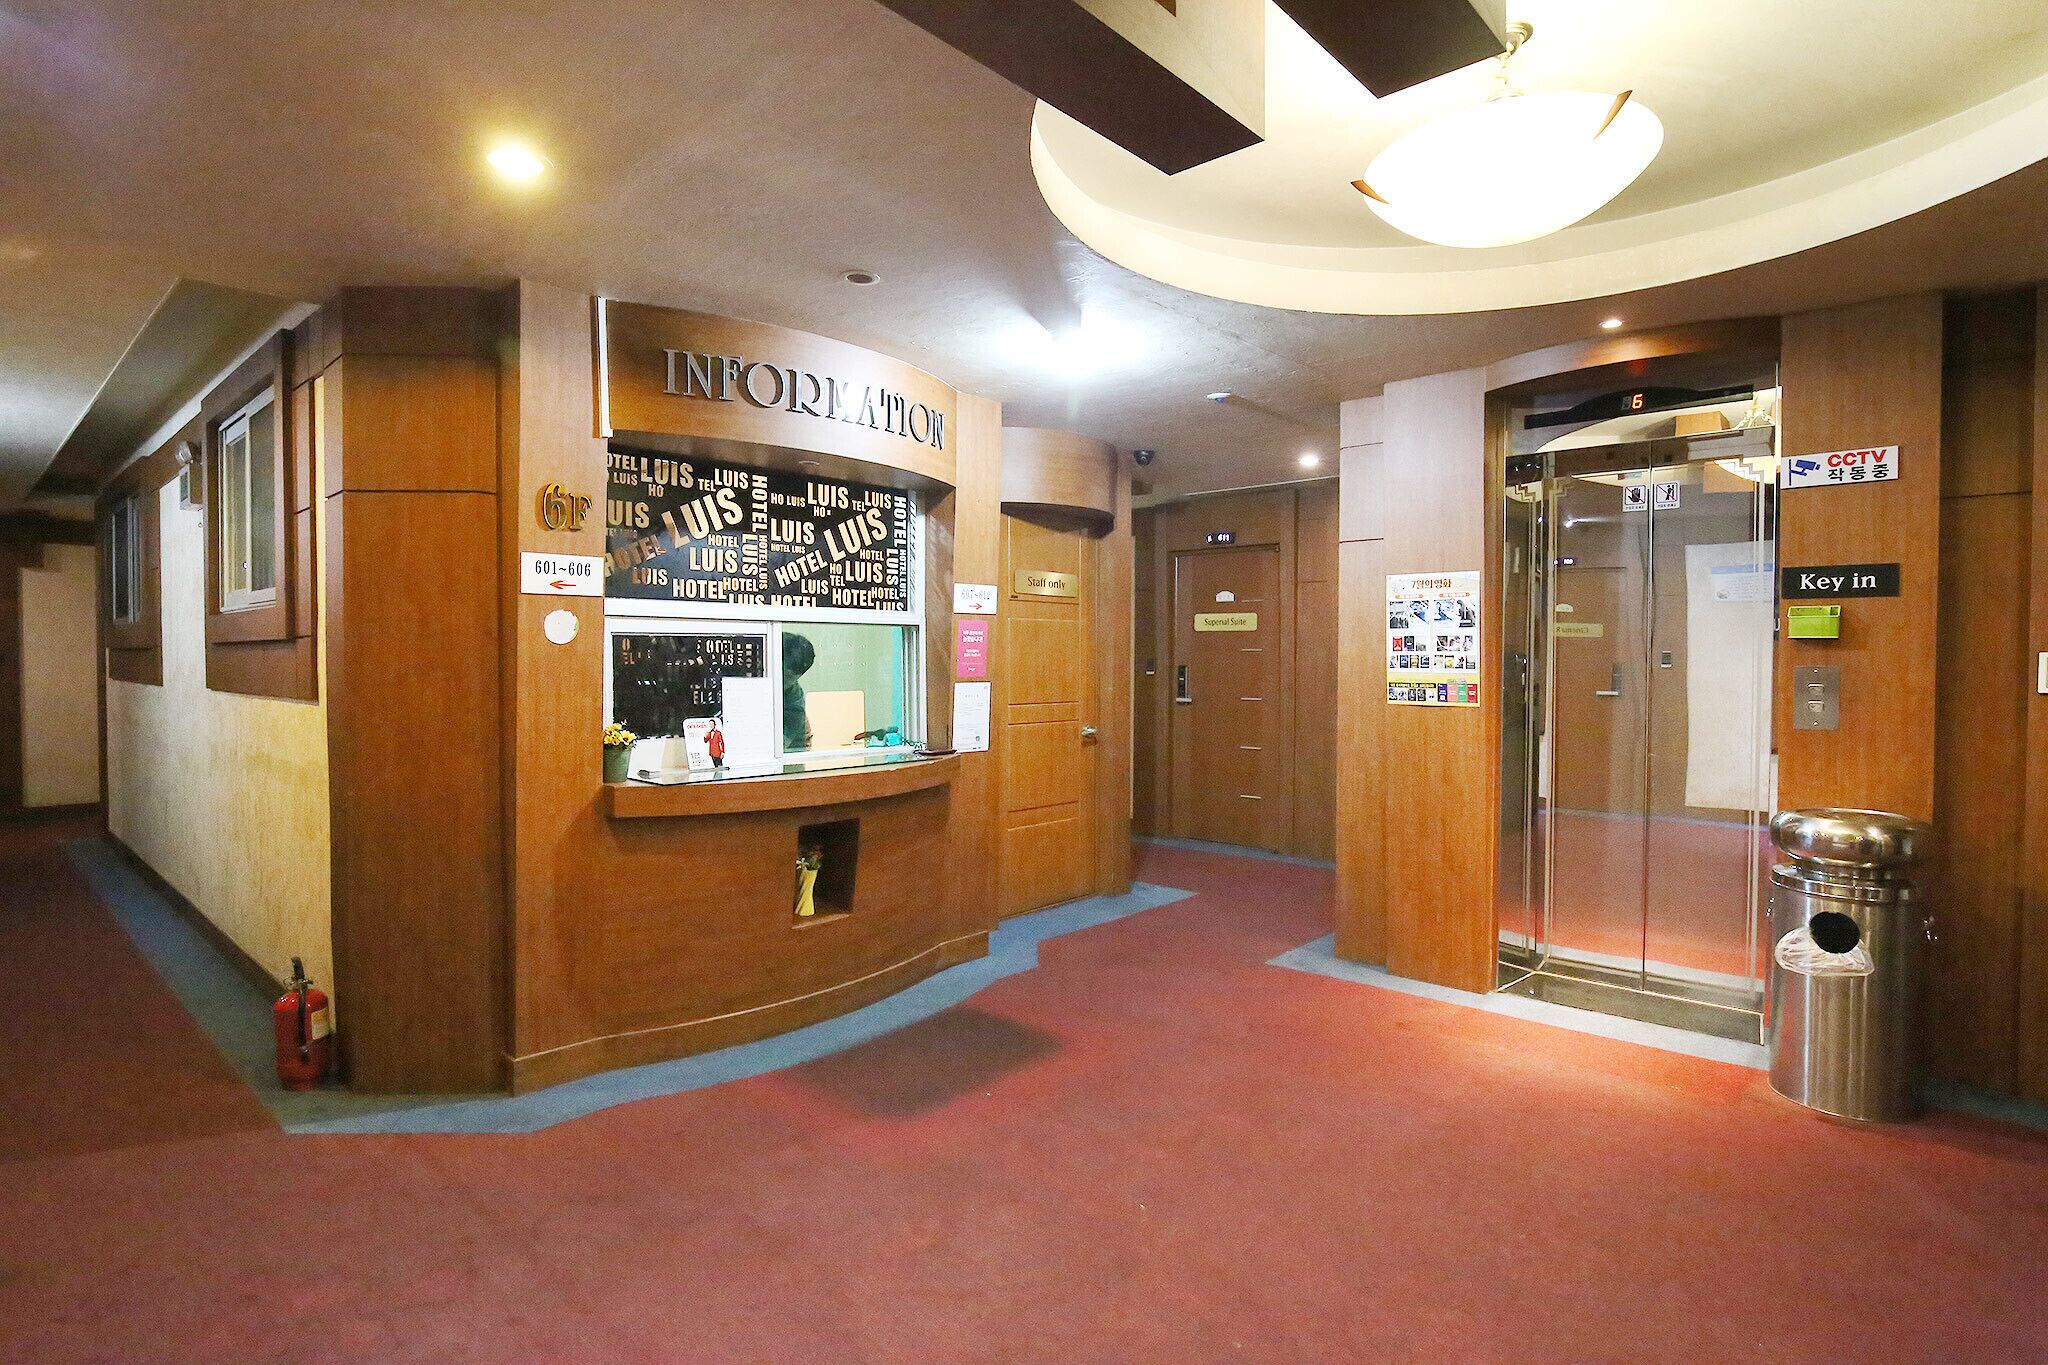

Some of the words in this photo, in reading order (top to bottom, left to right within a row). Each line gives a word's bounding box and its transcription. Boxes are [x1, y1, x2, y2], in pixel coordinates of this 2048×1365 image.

[663, 348, 945, 450] INFORMATION
[1632, 393, 1643, 409] 6
[1827, 449, 1887, 468] CCTV
[641, 457, 694, 489] LUIS
[714, 468, 749, 490] LUIS
[698, 478, 717, 492] TEL
[807, 482, 849, 510] LUIS
[536, 482, 592, 531] 6F
[751, 474, 768, 533] HOTEL
[864, 490, 892, 510] LUIS
[661, 487, 744, 549] LUIS
[893, 495, 907, 548] HOTEL
[708, 533, 740, 548] HOTEL
[770, 518, 816, 546] LUIS
[742, 533, 759, 576] LUIS
[774, 549, 829, 589] HOTEL
[823, 507, 888, 562] LUIS
[860, 548, 885, 561] HOTEL
[535, 559, 591, 577] 601~606
[689, 546, 738, 574] LUIS
[886, 548, 899, 586] LUIS
[632, 566, 668, 586] LUIS
[846, 560, 884, 584] LUIS
[1027, 576, 1047, 588] Staff
[1800, 573, 1845, 592] Key
[1852, 572, 1877, 589] in
[672, 578, 727, 600] HOTEL
[723, 576, 760, 593] HOTEL
[801, 578, 830, 596] LUIS
[870, 586, 900, 600] HOTEL
[832, 588, 875, 607] HOTEL
